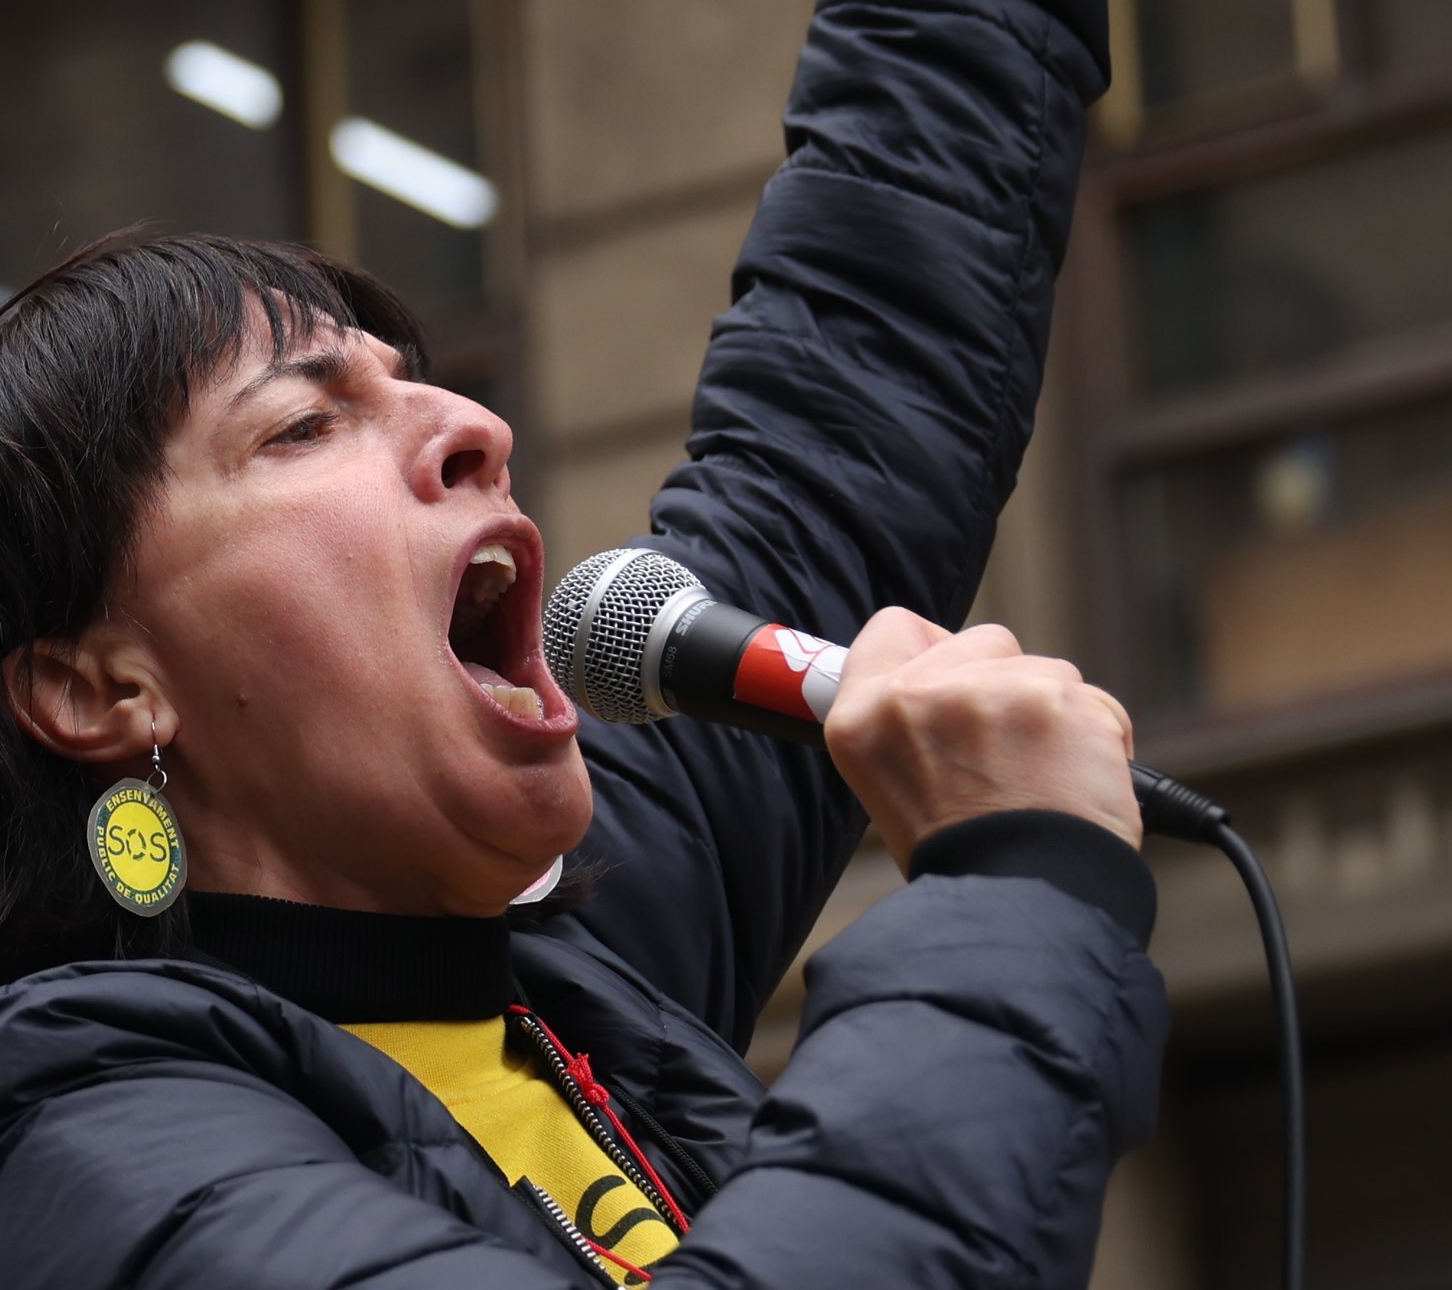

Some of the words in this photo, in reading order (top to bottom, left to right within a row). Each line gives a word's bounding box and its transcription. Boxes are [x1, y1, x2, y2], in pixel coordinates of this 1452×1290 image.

[106, 789, 180, 849] ENSENYAMENT
[108, 824, 167, 862] SOS
[116, 882, 132, 899] DE
[134, 863, 181, 904] QUALITAT
